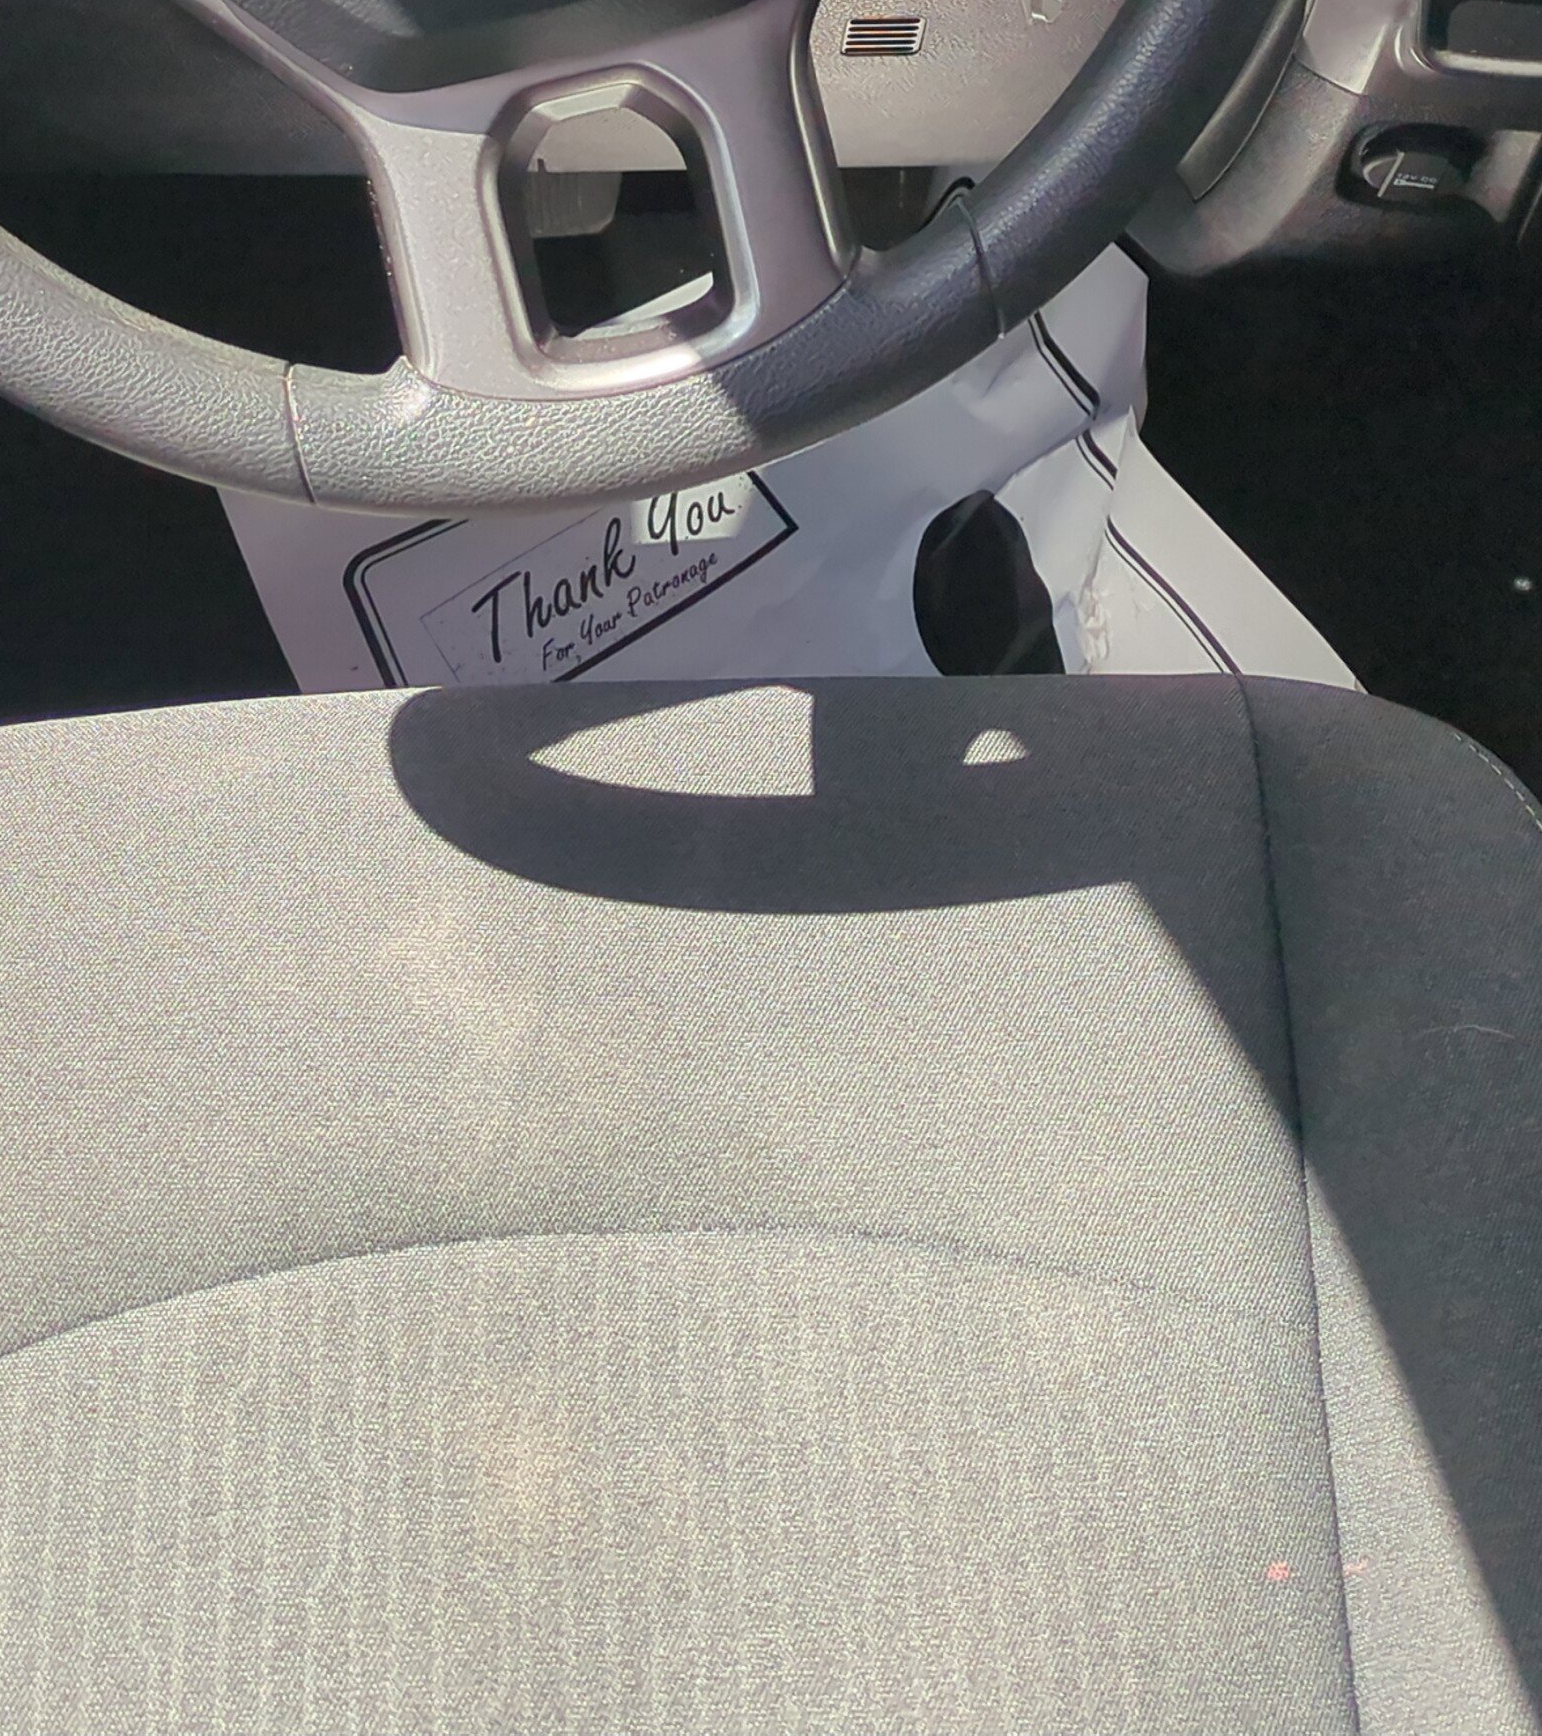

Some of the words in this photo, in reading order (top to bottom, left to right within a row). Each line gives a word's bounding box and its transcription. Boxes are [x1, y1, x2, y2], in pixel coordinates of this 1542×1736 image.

[471, 518, 636, 664] Thank
[648, 491, 735, 556] You
[543, 638, 575, 671] For
[580, 613, 623, 645] Your
[627, 552, 719, 617] Patronage
